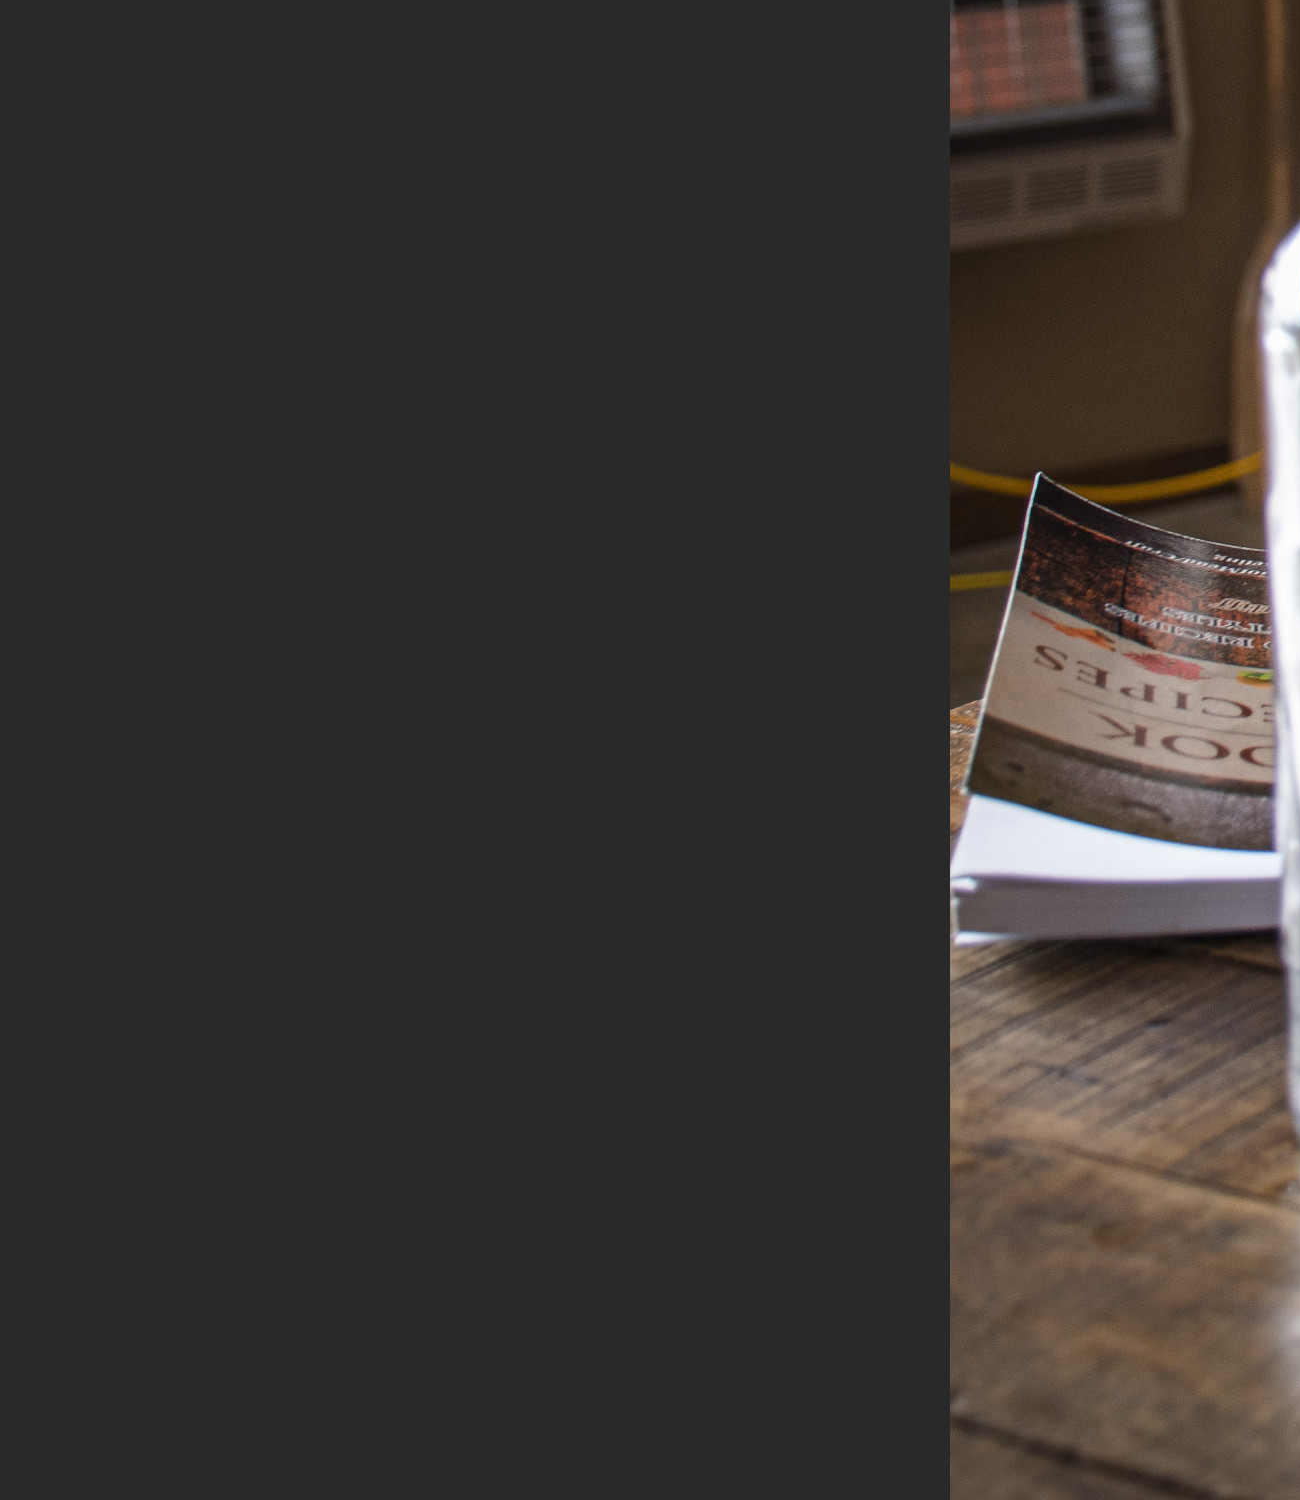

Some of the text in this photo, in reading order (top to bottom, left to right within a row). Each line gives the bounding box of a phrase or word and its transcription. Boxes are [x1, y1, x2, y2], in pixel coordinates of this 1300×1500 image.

[1163, 607, 1271, 634] TYLES
[1033, 644, 1275, 725] ECIPES
[1095, 712, 1277, 768] OOK
